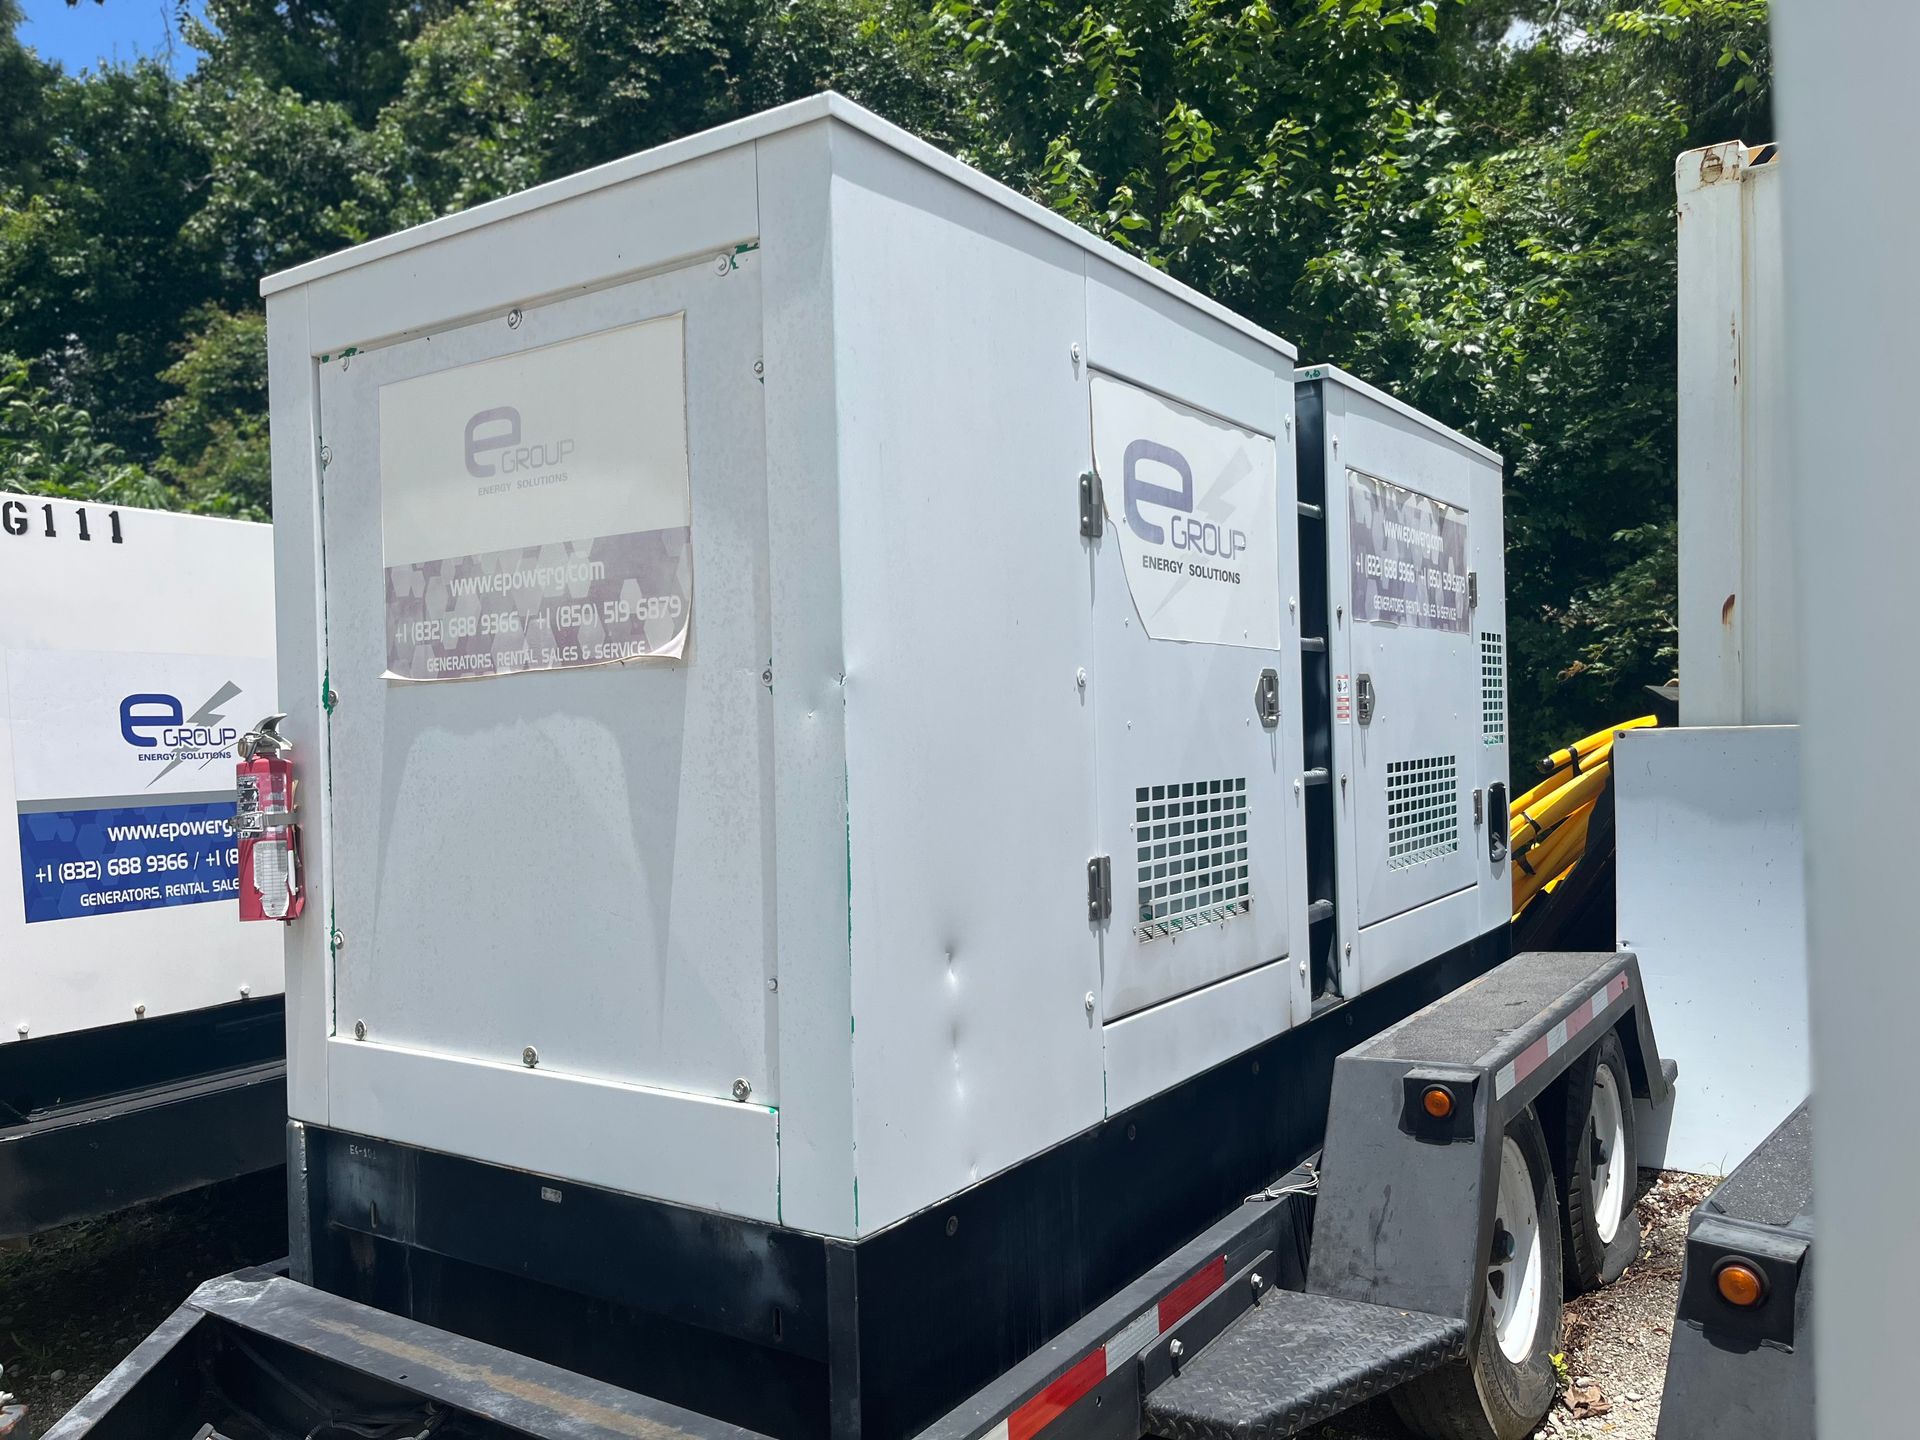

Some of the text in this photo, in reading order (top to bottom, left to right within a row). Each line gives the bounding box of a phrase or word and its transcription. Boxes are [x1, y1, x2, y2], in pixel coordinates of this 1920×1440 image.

[464, 405, 575, 478] e GROUP
[478, 472, 568, 496] ENERGY SOLUTIONS
[1123, 438, 1247, 560] e GROUP
[1383, 519, 1443, 553] www.epowerg.com
[450, 561, 605, 597] www.epowerg.com
[1142, 555, 1241, 584] ENERGY SOLUTIONS
[1384, 558, 1398, 580] 688
[1399, 561, 1415, 583] 9366
[411, 620, 444, 645] (832)
[448, 616, 477, 638] 688
[480, 611, 519, 635] 9366
[556, 603, 598, 631] (850)
[604, 600, 631, 624] 519
[636, 595, 682, 621] 6879
[497, 649, 538, 668] RENTAL
[541, 646, 578, 663] SALES
[582, 647, 591, 660] &
[595, 640, 646, 659] SERVICE
[120, 694, 236, 747] e GROUP
[138, 751, 231, 761] ENERGY SOLUTIONS
[108, 820, 236, 842] www.epowerg.
[35, 864, 52, 883] +1
[58, 860, 101, 884] (832)
[107, 857, 142, 877] 688
[146, 853, 189, 872] 9366
[193, 851, 199, 870] /
[205, 849, 220, 867] +1
[165, 881, 209, 898] RENTAL
[212, 878, 239, 892] SALE
